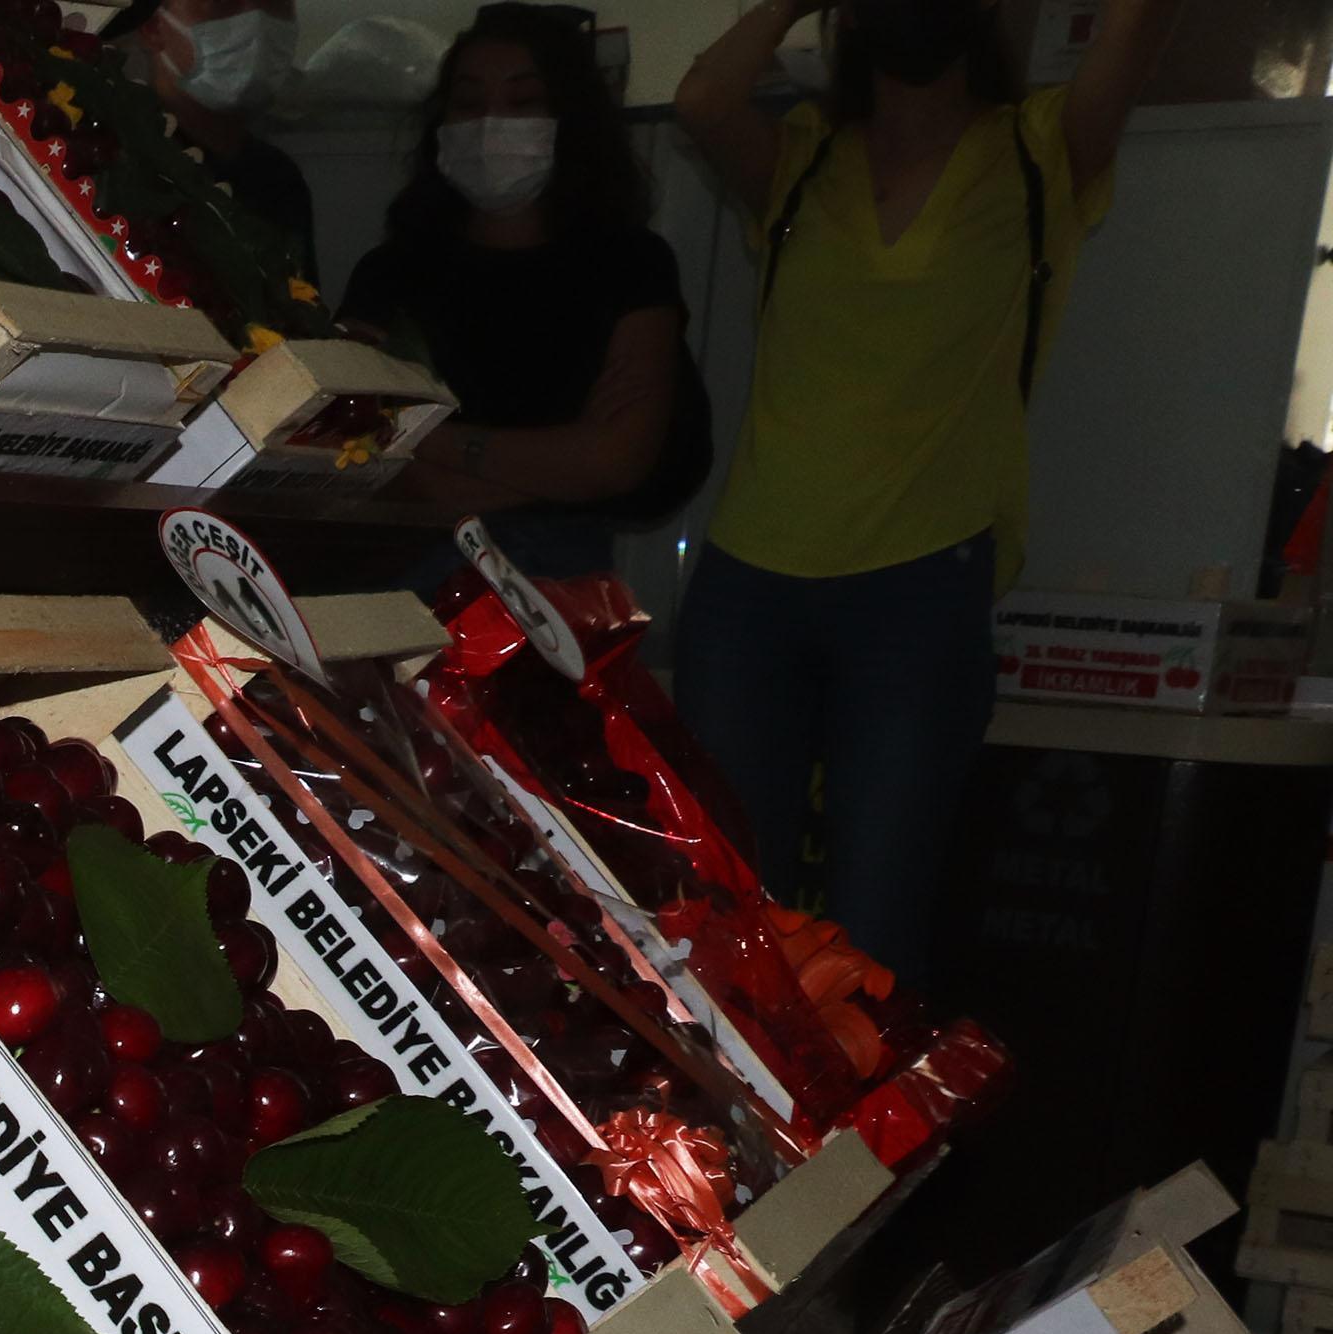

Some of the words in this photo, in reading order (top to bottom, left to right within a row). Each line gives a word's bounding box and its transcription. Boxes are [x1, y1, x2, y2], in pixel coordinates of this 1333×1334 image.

[191, 520, 264, 579] ÇEŞİT
[212, 576, 286, 641] 11
[153, 729, 306, 898] LAPSEKİ
[284, 889, 452, 1087] BELEDİYE
